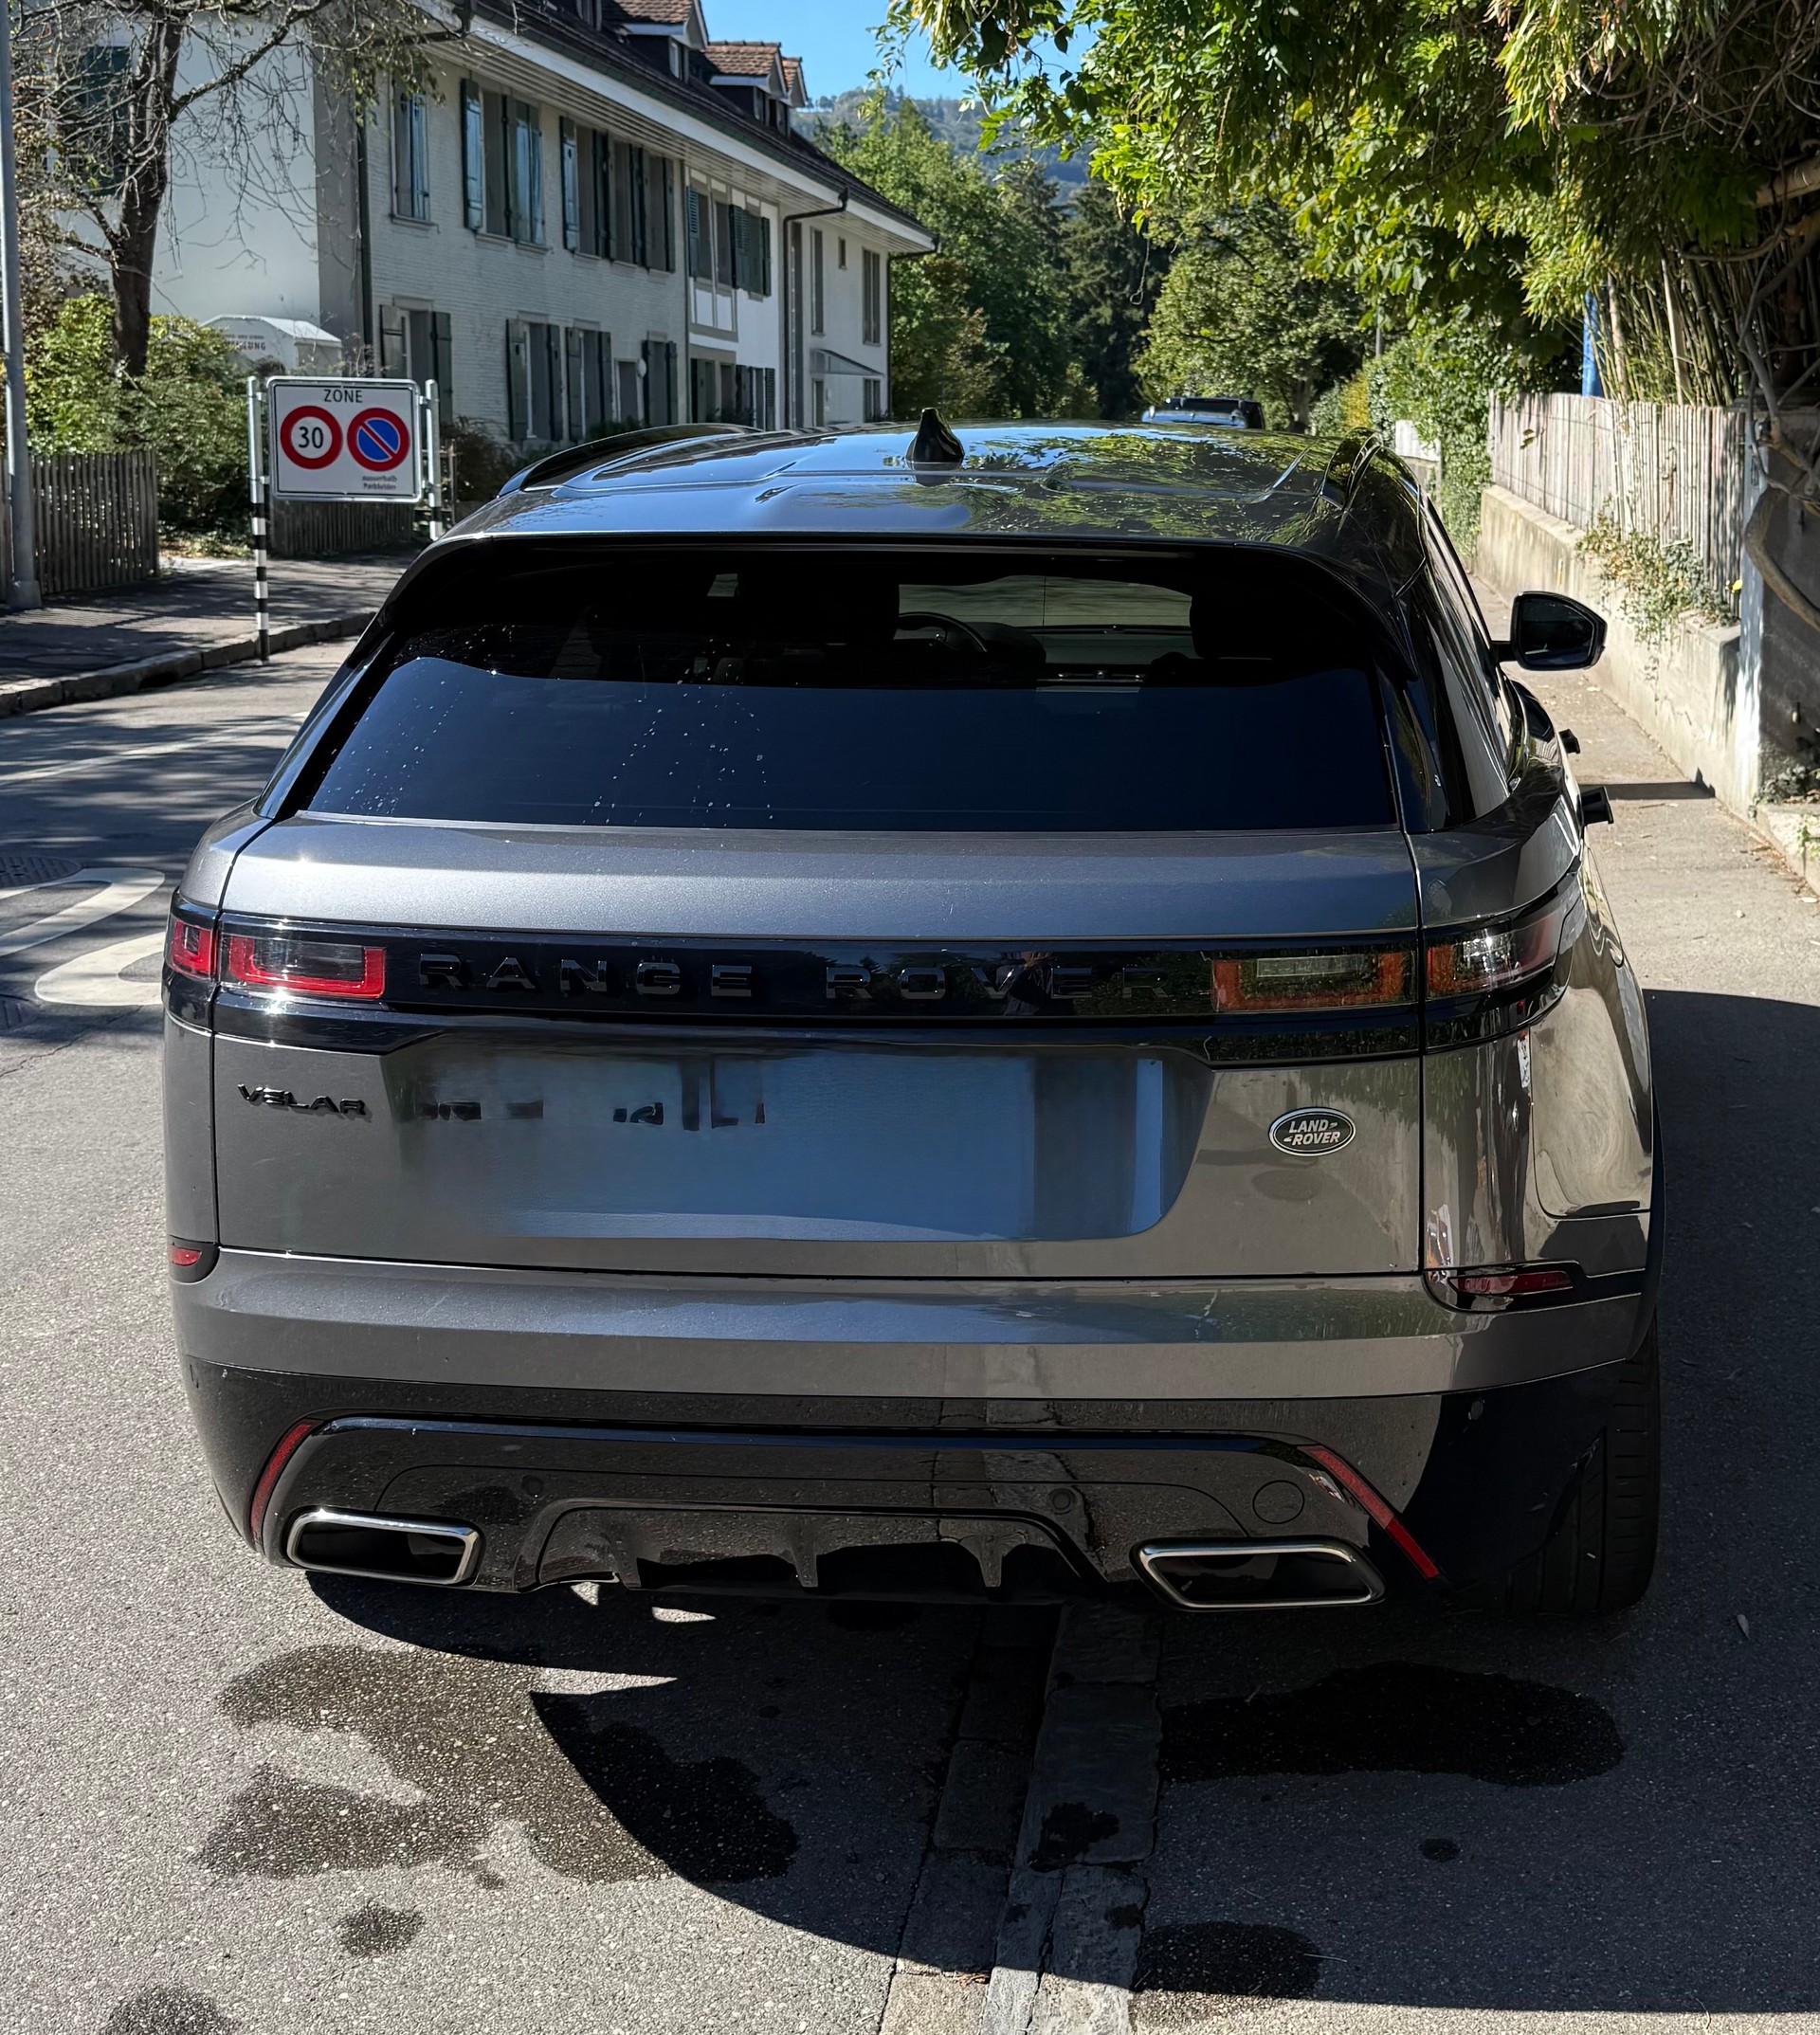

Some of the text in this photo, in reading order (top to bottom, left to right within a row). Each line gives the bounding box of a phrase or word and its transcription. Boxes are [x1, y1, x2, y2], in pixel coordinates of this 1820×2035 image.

[324, 389, 363, 404] ZONE
[298, 426, 324, 448] 30
[419, 953, 1169, 1000] RANGE ROVER
[237, 1083, 367, 1116] VELAR
[1288, 1119, 1329, 1134] LAND
[1291, 1131, 1341, 1146] ROVER
